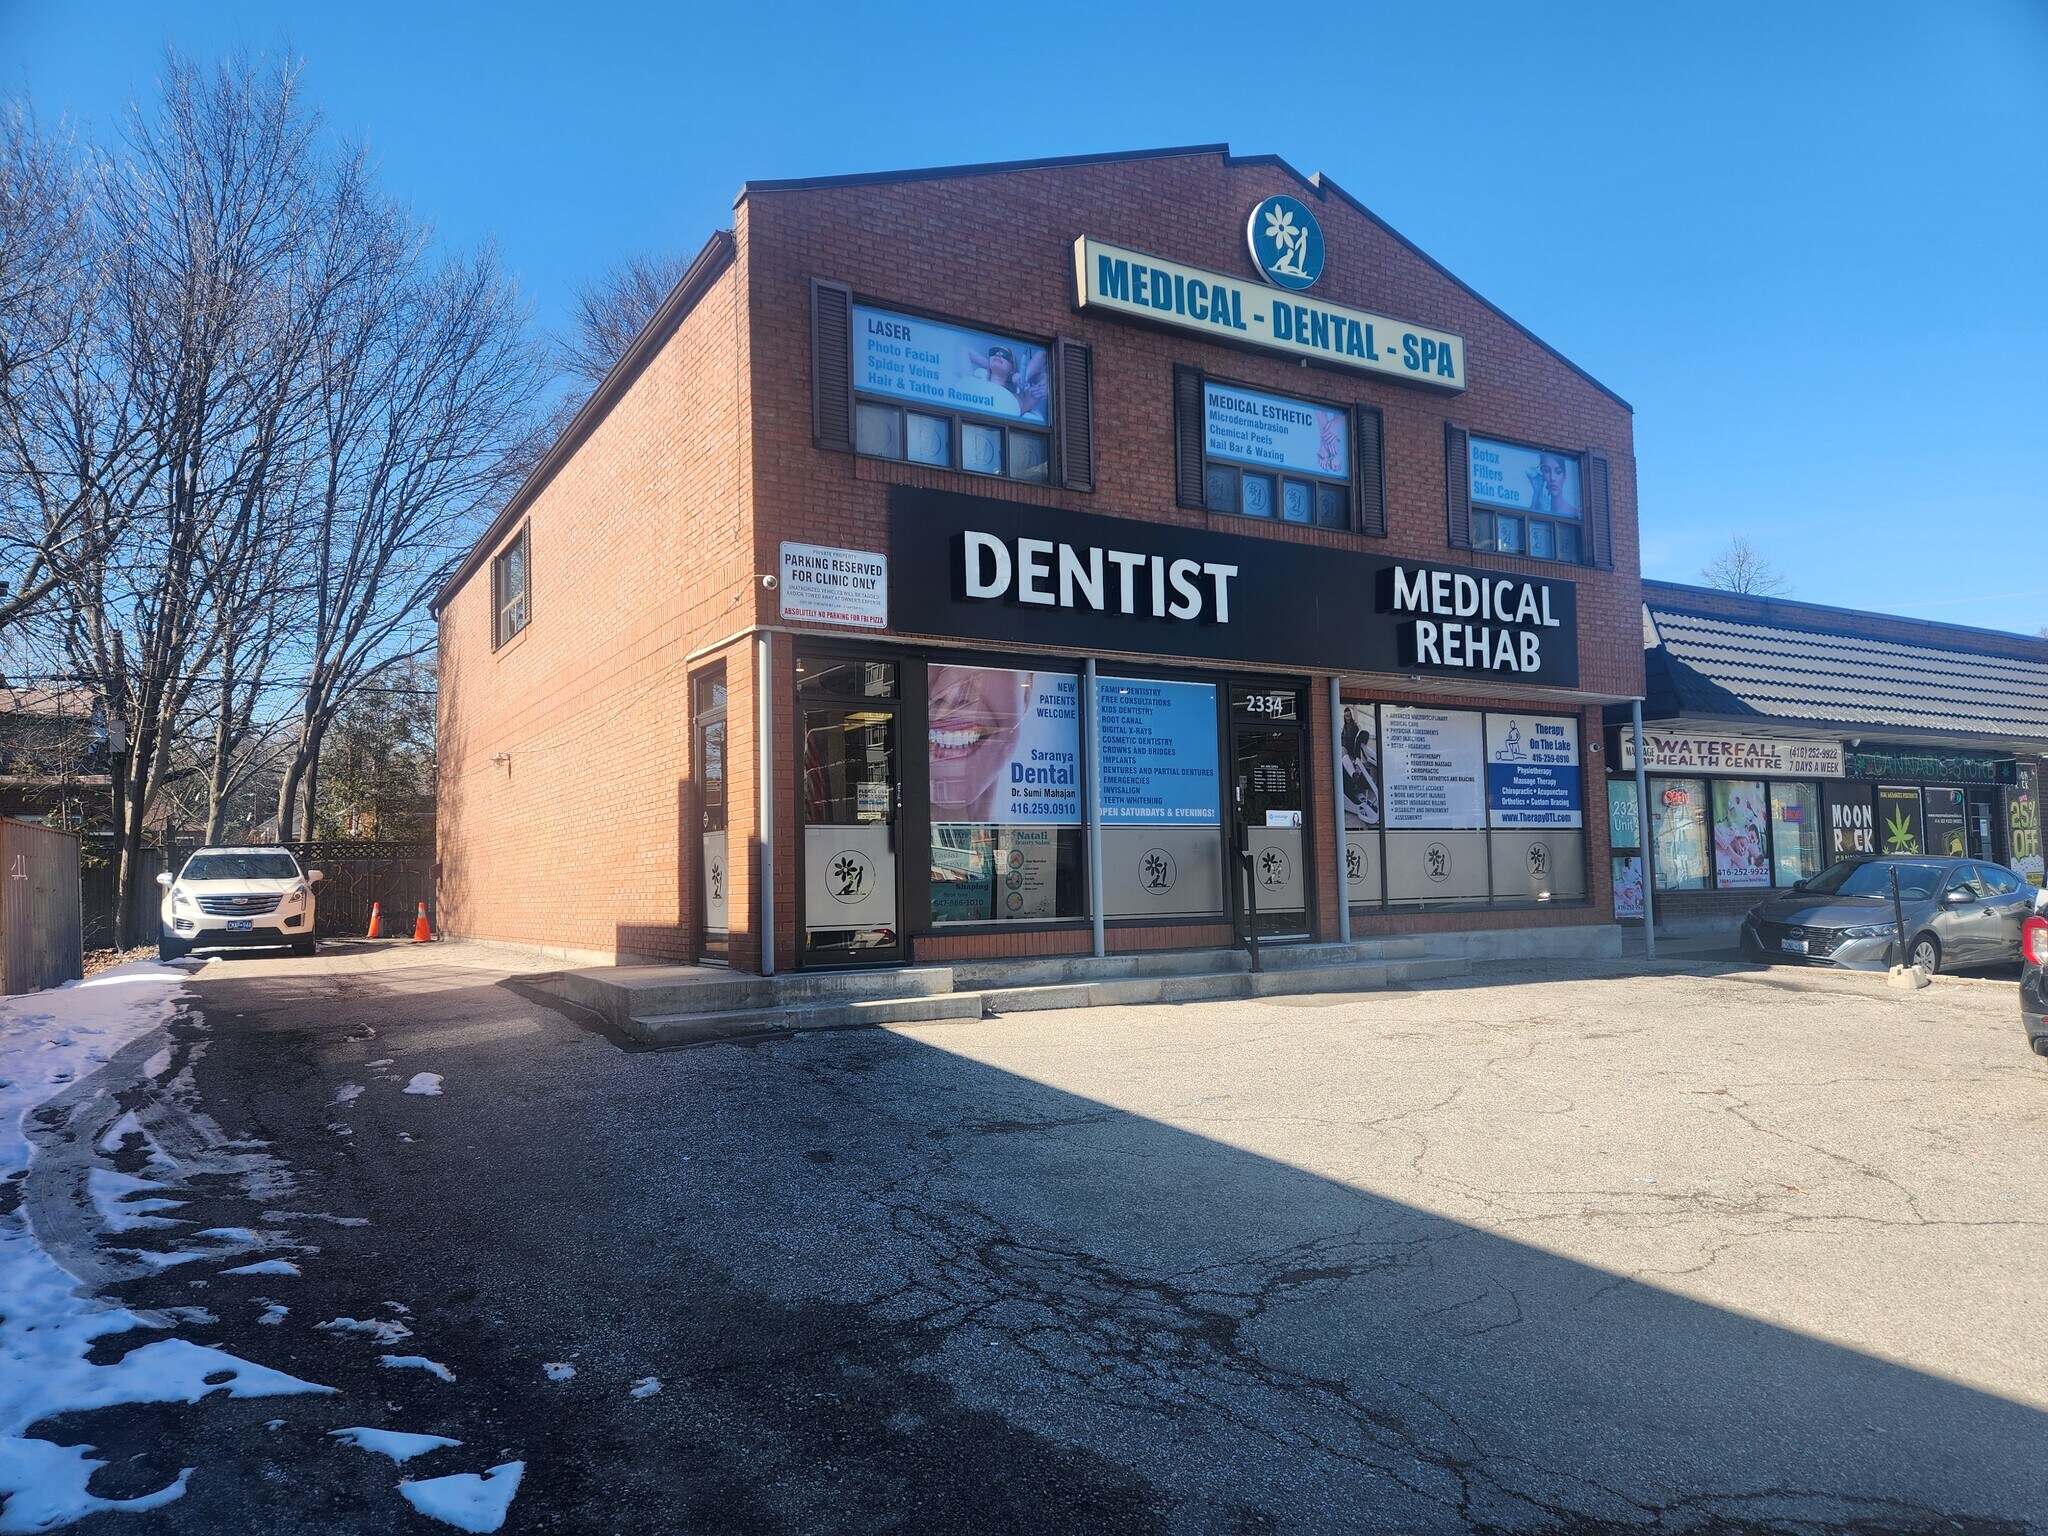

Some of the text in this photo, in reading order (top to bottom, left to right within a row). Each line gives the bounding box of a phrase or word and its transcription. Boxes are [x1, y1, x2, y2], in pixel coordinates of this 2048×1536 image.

[1098, 254, 1247, 331] MEDICAL
[1273, 300, 1379, 361] DENTAL
[1402, 333, 1454, 378] SPA
[868, 318, 911, 342] LASER
[868, 339, 940, 365] Photo Facial
[868, 355, 940, 380] Spider Veins
[868, 371, 994, 407] Hair & Tattoo Removal
[1209, 393, 1313, 426] MEDICAL ESTHETIC
[1210, 410, 1289, 434] Microdermabrasion
[1210, 425, 1273, 445] Chemical Peels
[1210, 438, 1285, 463] Nail Bar & Waxing
[1473, 447, 1500, 465] Botox
[1473, 464, 1503, 481] Fillers
[1474, 480, 1520, 501] Skin Care
[785, 554, 882, 576] PARKING RESERVED
[792, 570, 876, 590] FOR CLINIC ONLY
[964, 530, 1238, 624] DENTIST
[1393, 565, 1560, 628] MEDICAL
[785, 607, 816, 616] ABSOLUTELY
[826, 611, 849, 620] PARKING
[870, 616, 883, 624] PIZZA
[1415, 619, 1541, 673] REHAB
[1058, 683, 1075, 692] NEW
[1127, 688, 1161, 696] DENTISTRY
[1040, 695, 1075, 706] PATIENTS
[1120, 697, 1171, 707] CONSULTATIONS
[1246, 695, 1283, 713] 2334
[1037, 708, 1075, 719] WELCOME
[1119, 707, 1154, 715] DENTISTRY
[1102, 726, 1152, 735] DIGITAL X-RAYS
[1536, 723, 1564, 736] Therapy
[1103, 736, 1136, 744] COSMETIC
[1530, 739, 1571, 751] On The Lake
[1103, 746, 1131, 754] CROWNS
[1148, 748, 1176, 756] BRIDGES
[1652, 736, 1781, 758] WATERFALL
[1789, 746, 1838, 759] (416) 252-9922
[1031, 749, 1073, 764] Saranya
[1103, 756, 1136, 764] IMPLANTS
[1532, 754, 1569, 763] 416-259-0910
[1656, 755, 1782, 769] HEALTH CENTRE
[1103, 766, 1137, 774] DENTURES
[1517, 767, 1552, 776] Physiotherapy
[1789, 761, 1839, 773] 7 DAYS A WEEK
[1873, 752, 1948, 777] CANNABIS
[1953, 757, 1994, 780] STORE
[1011, 762, 1074, 784] Dental
[1513, 777, 1556, 786] Massage Therapy
[1012, 788, 1075, 799] Dr. Sumi Mahajan
[1502, 787, 1568, 796] Chiropractic Acupuncture
[1664, 790, 1690, 804] OPEN
[1104, 796, 1124, 804] TEETH
[1551, 799, 1569, 807] Bracing
[1011, 803, 1075, 814] 416.259.0910
[1100, 808, 1118, 816] OPEN
[1121, 808, 1165, 816] SATURDAYS
[1175, 809, 1214, 817] EVENINGS!
[1612, 801, 1638, 816] 2324
[2010, 800, 2037, 829] 25%
[1502, 813, 1571, 822] www.TherapyOTL.com
[1831, 804, 1872, 828] MOON
[1614, 818, 1633, 831] Unit
[1016, 832, 1047, 840] Natali
[2013, 829, 2039, 862] OFF
[1718, 868, 1768, 876] 416-252-9922
[955, 883, 989, 891] Shaping
